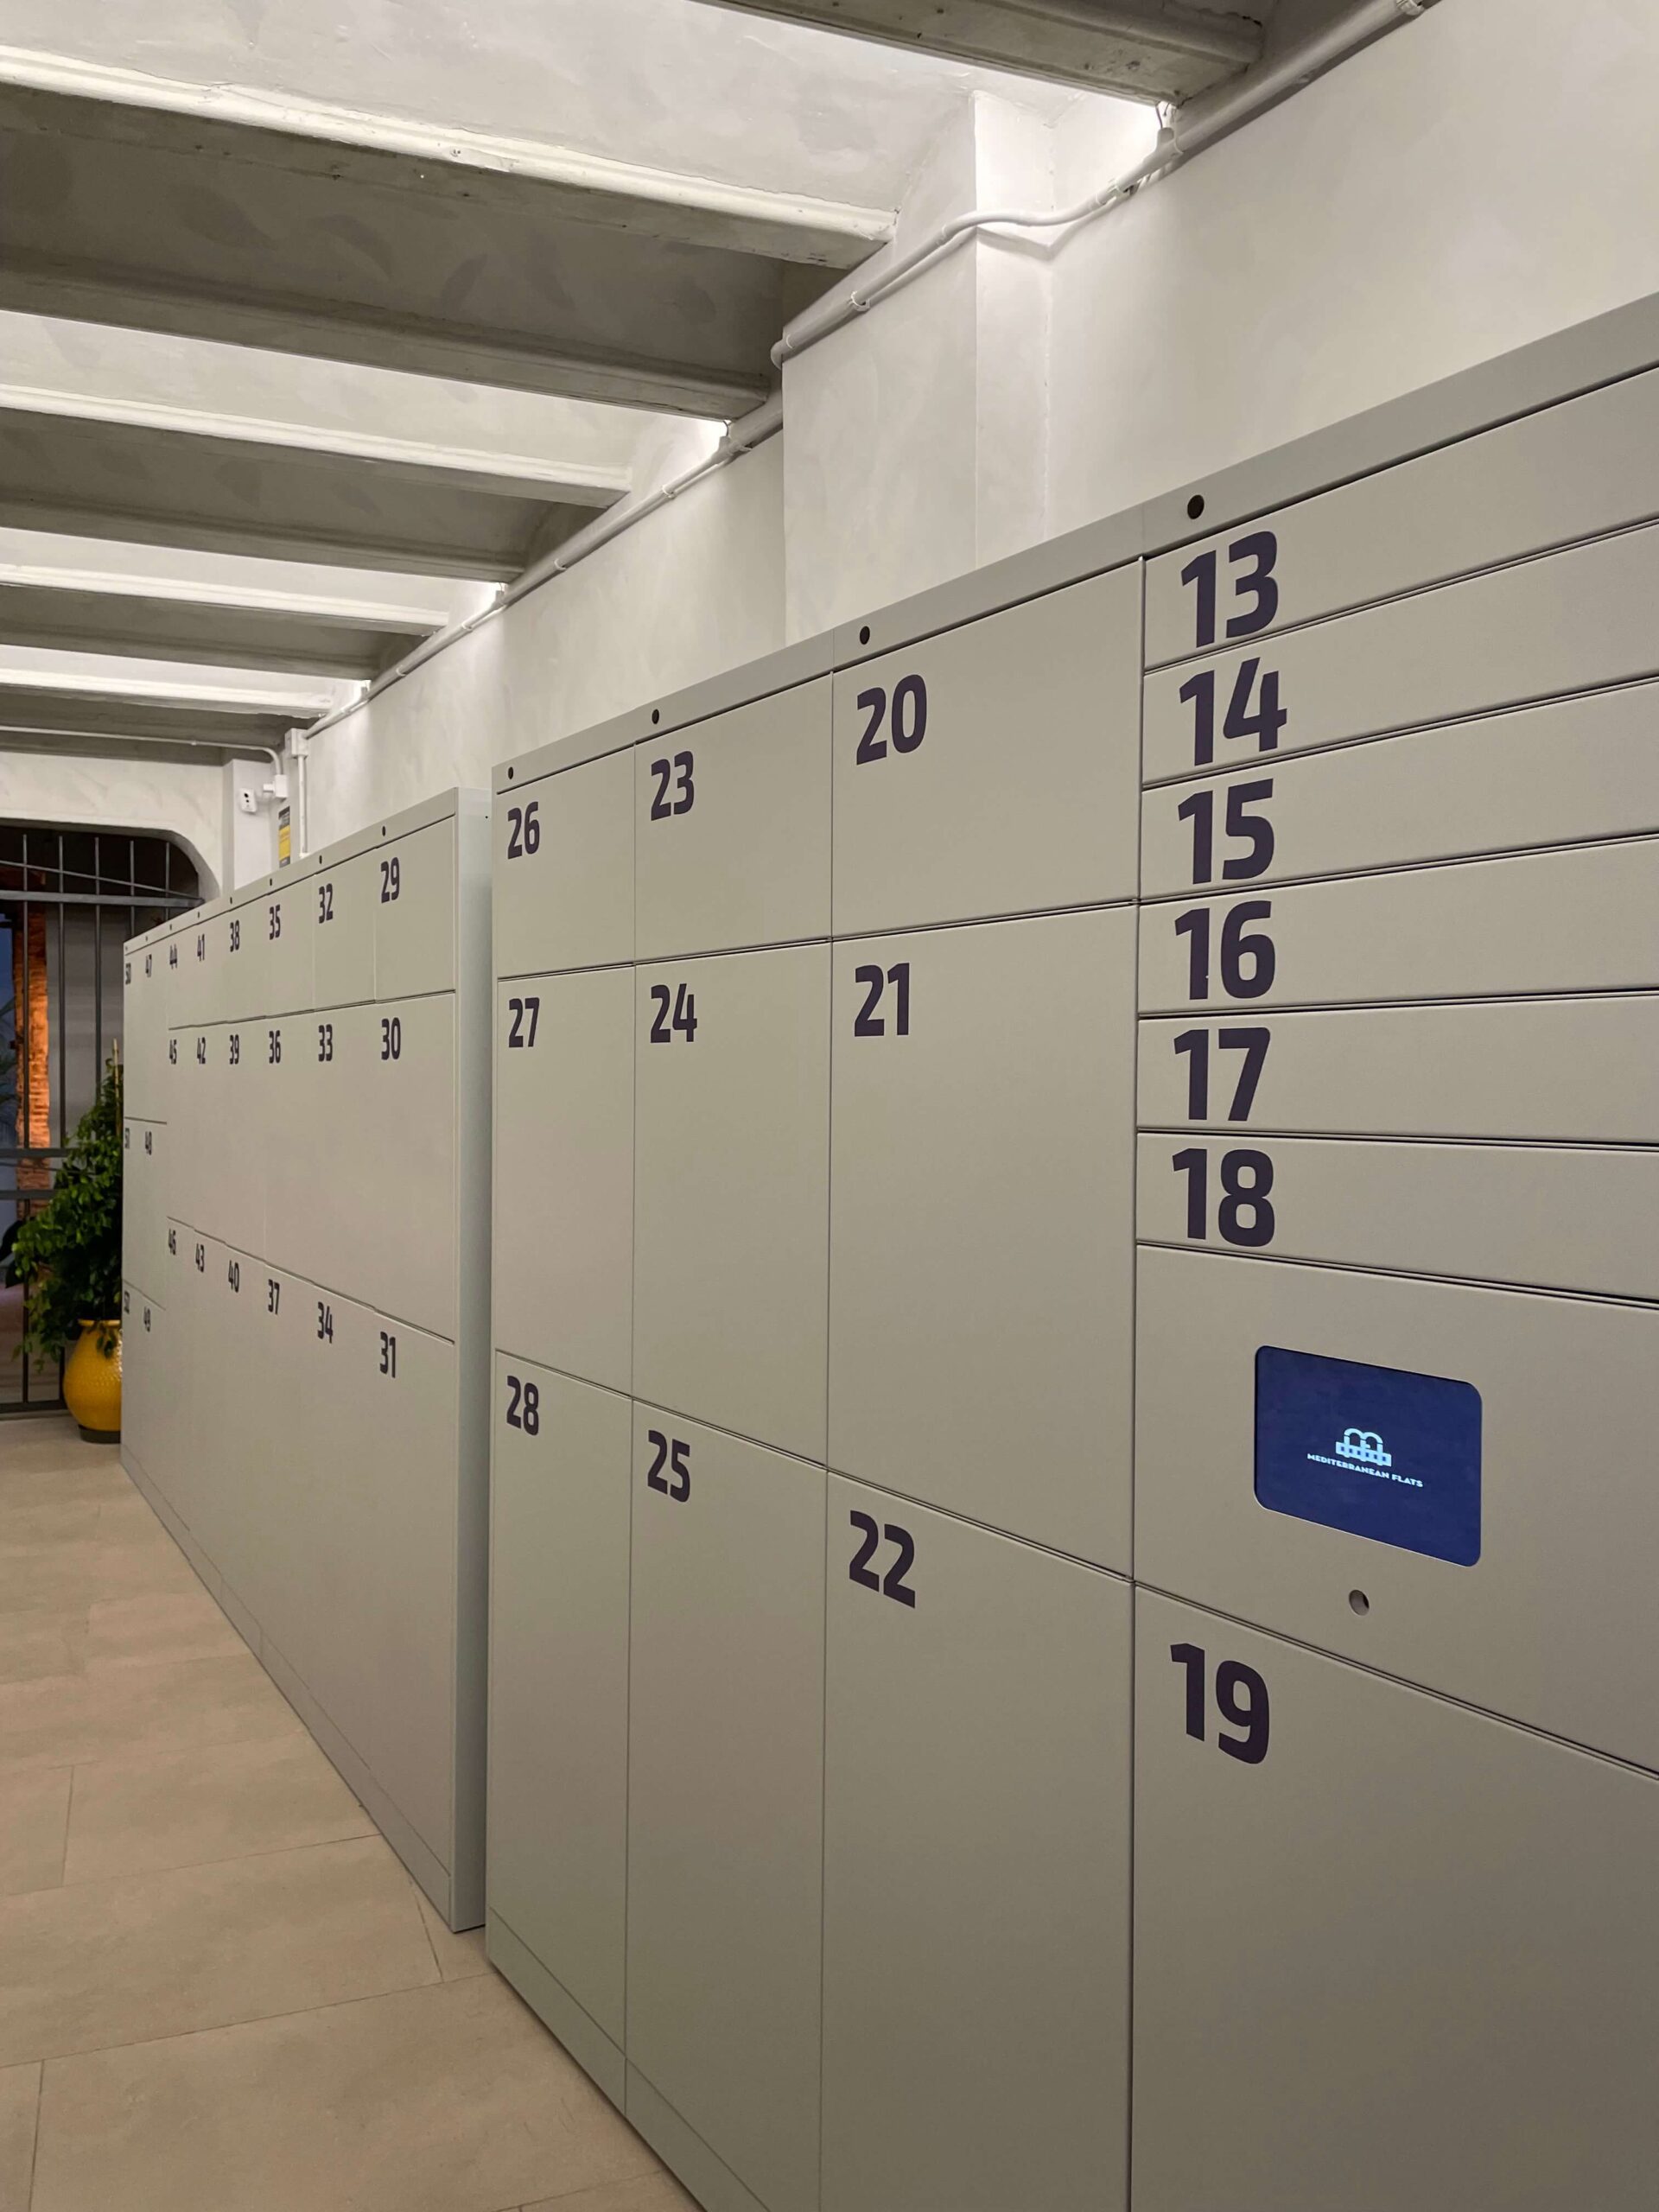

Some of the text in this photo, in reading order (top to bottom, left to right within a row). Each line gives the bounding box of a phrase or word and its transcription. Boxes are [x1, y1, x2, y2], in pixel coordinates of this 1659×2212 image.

[1181, 531, 1278, 647] 13
[857, 675, 926, 765] 20
[1179, 658, 1287, 766] 14
[652, 751, 694, 821] 23
[508, 802, 539, 859] 26
[1178, 779, 1274, 884] 15
[318, 883, 334, 924] 32
[380, 856, 400, 904] 29
[230, 919, 240, 953] 38
[269, 904, 281, 941] 35
[169, 944, 177, 969] 44
[197, 933, 205, 962] 41
[1175, 900, 1275, 1000] 16
[509, 997, 539, 1047] 27
[651, 983, 697, 1043] 24
[855, 963, 909, 1037] 21
[169, 1039, 177, 1065] 45
[196, 1037, 207, 1065] 42
[229, 1033, 239, 1065] 39
[269, 1029, 282, 1065] 36
[318, 1024, 334, 1062] 33
[381, 1017, 402, 1061] 30
[1174, 1027, 1270, 1121] 17
[1173, 1148, 1274, 1247] 18
[168, 1230, 176, 1255] 46
[195, 1243, 205, 1273] 43
[227, 1260, 240, 1294] 40
[268, 1278, 280, 1315] 37
[317, 1301, 334, 1344] 34
[379, 1331, 397, 1379] 31
[507, 1376, 538, 1435] 28
[648, 1430, 690, 1502] 25
[1307, 1453, 1423, 1487] MEDITERRANEAN FLATS
[849, 1510, 915, 1608] 22
[1171, 1643, 1269, 1764] 19
